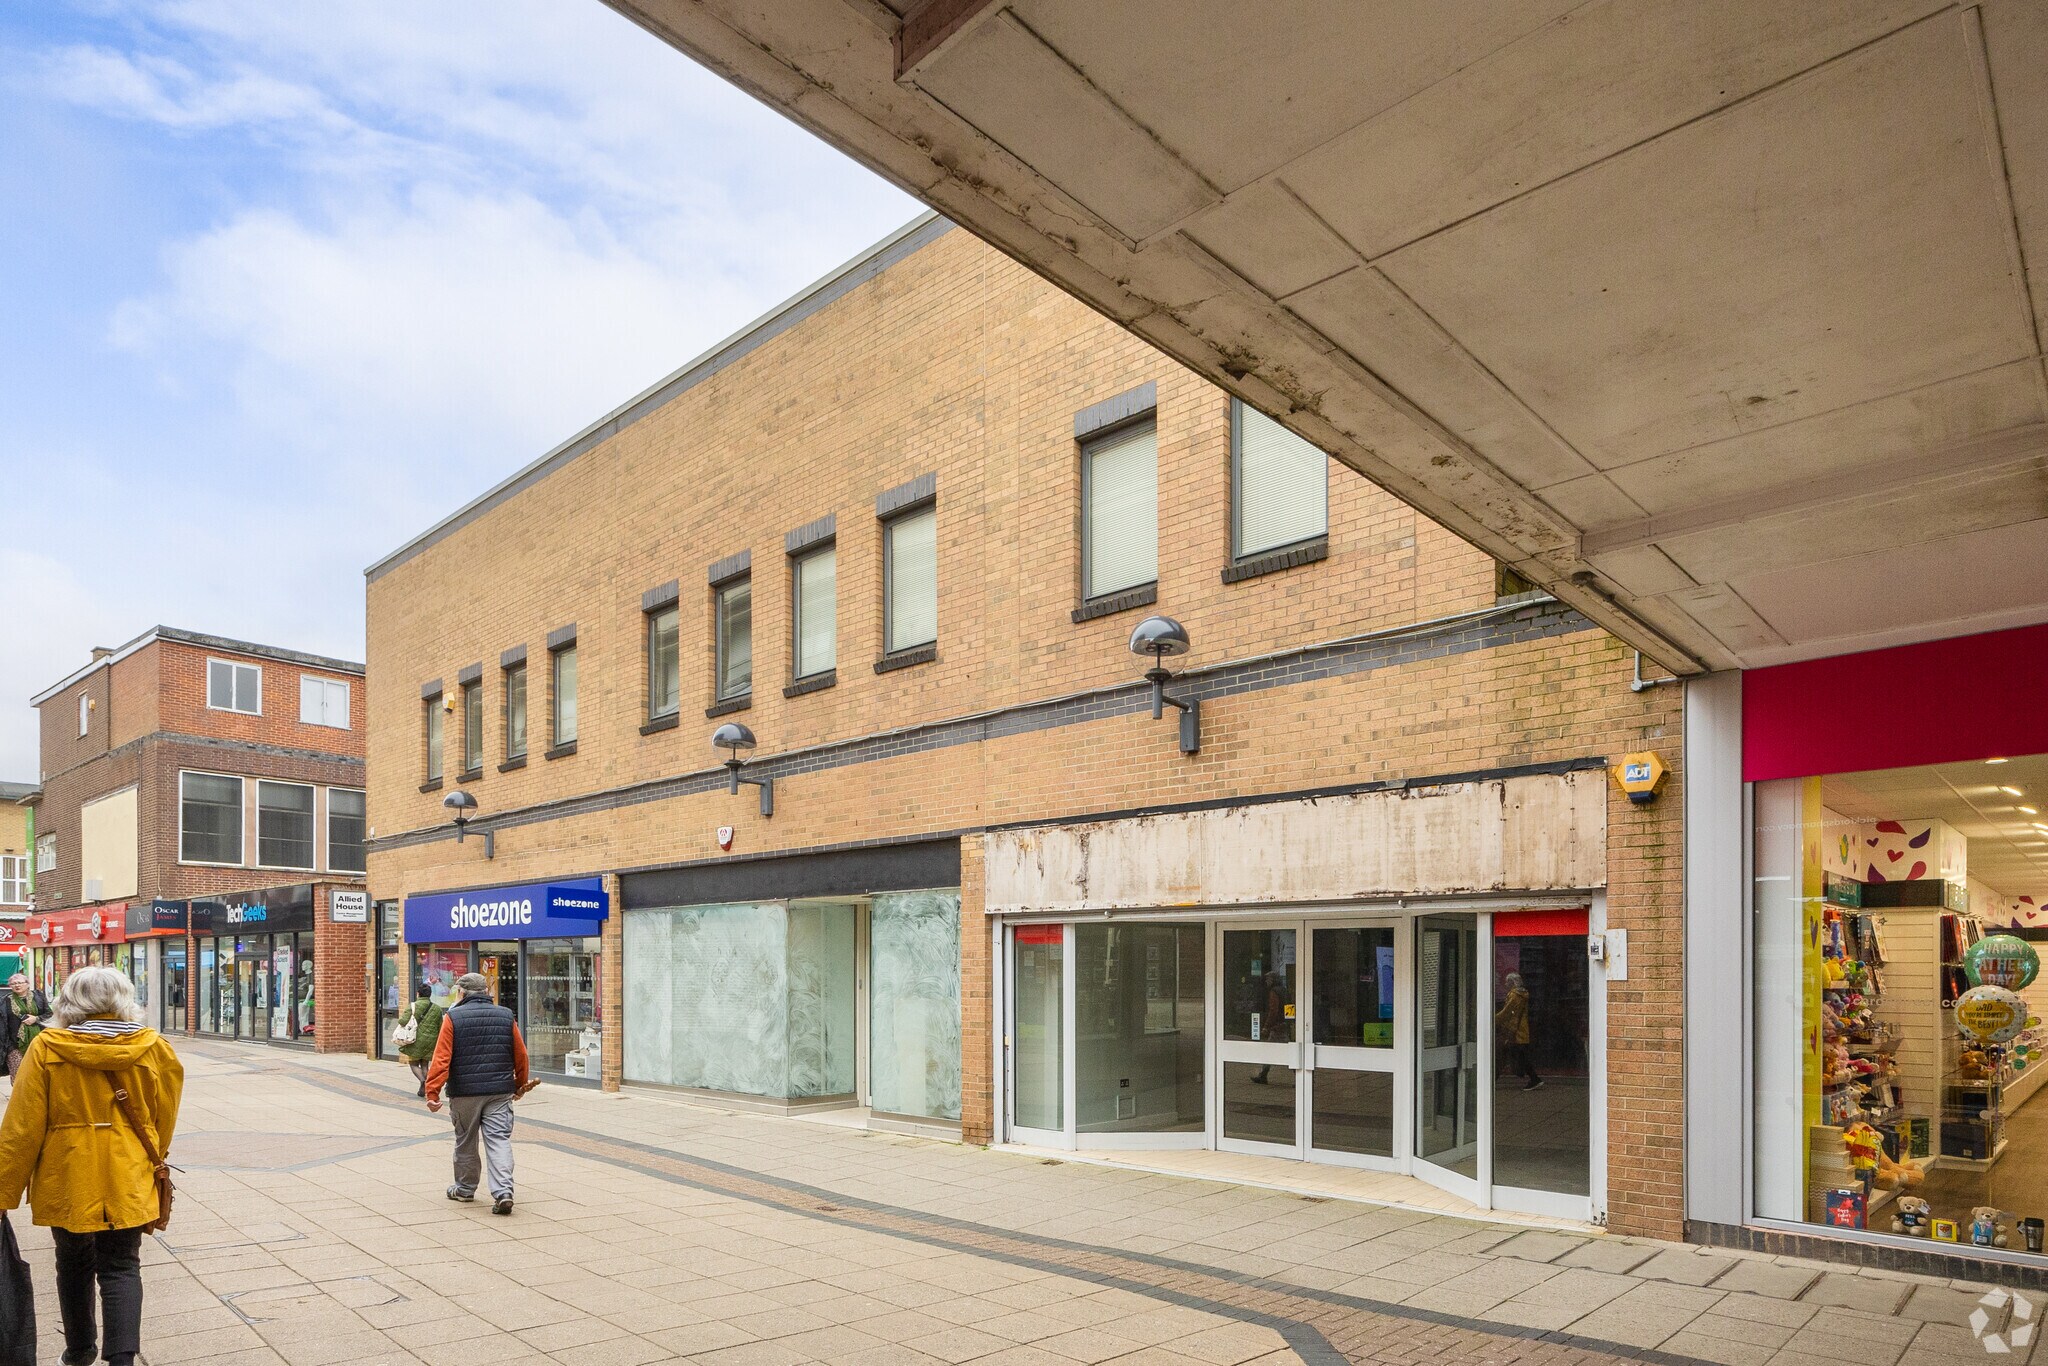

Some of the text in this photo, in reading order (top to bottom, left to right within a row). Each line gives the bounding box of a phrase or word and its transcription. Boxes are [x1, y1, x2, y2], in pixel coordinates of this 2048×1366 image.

[1626, 766, 1650, 779] ADT
[552, 897, 600, 909] shoezone
[450, 898, 532, 929] shoezone
[1984, 943, 2024, 955] HAPPY
